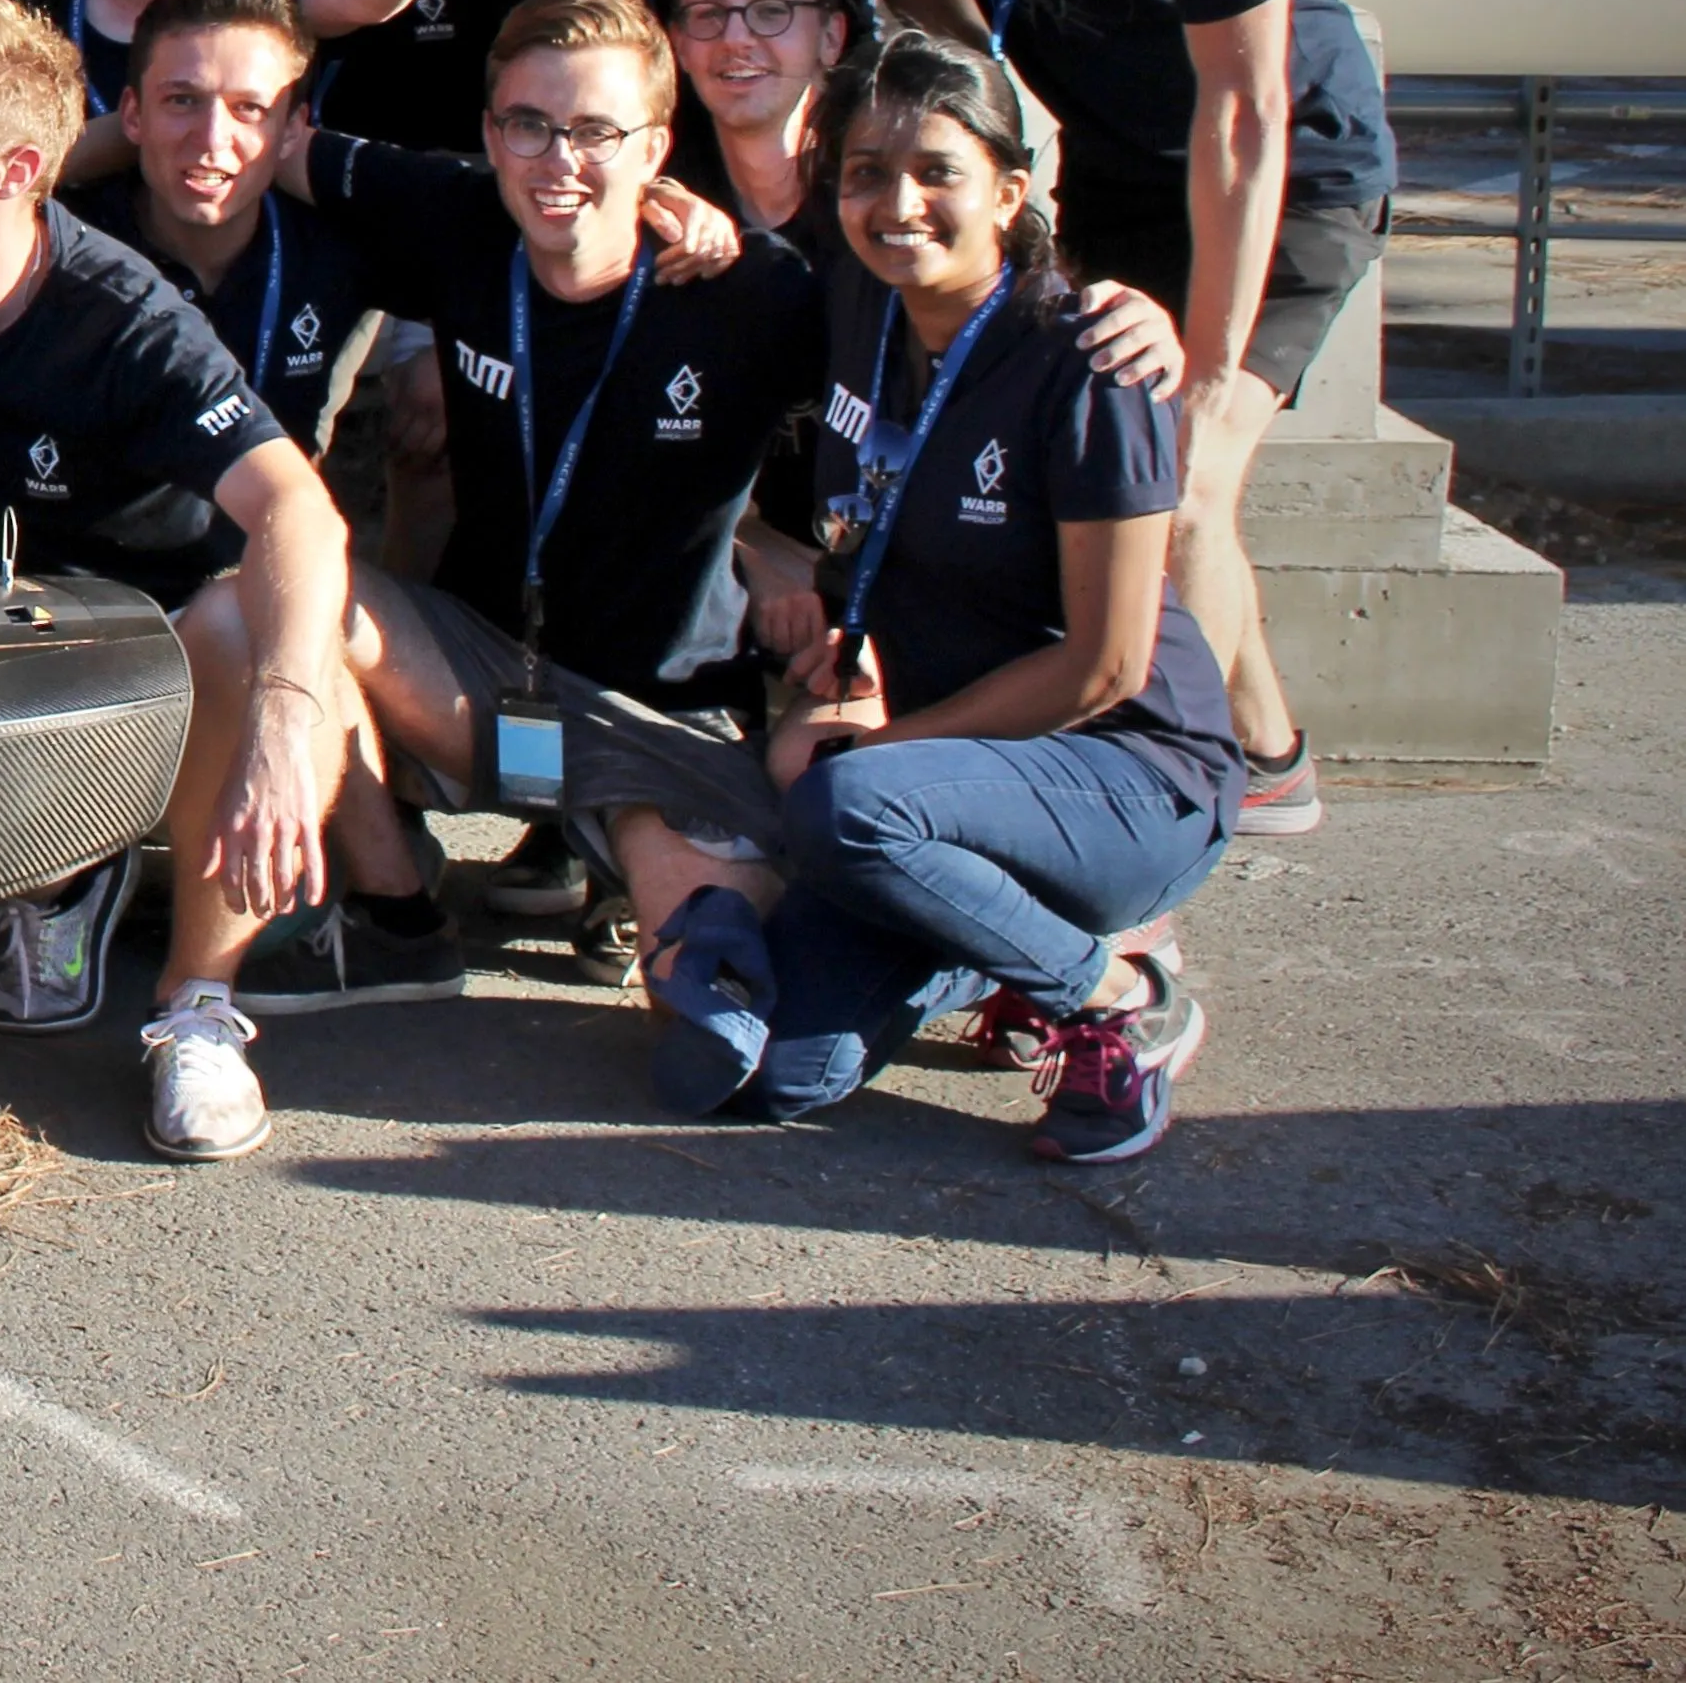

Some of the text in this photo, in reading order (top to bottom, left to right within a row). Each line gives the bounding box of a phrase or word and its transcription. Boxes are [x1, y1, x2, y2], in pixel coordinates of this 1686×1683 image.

[286, 351, 324, 367] WARR
[455, 341, 514, 401] TUM
[196, 394, 250, 436] TUM
[825, 382, 872, 444] TUM
[657, 418, 702, 431] WARR
[25, 476, 69, 495] WARR
[961, 496, 1007, 513] WARR
